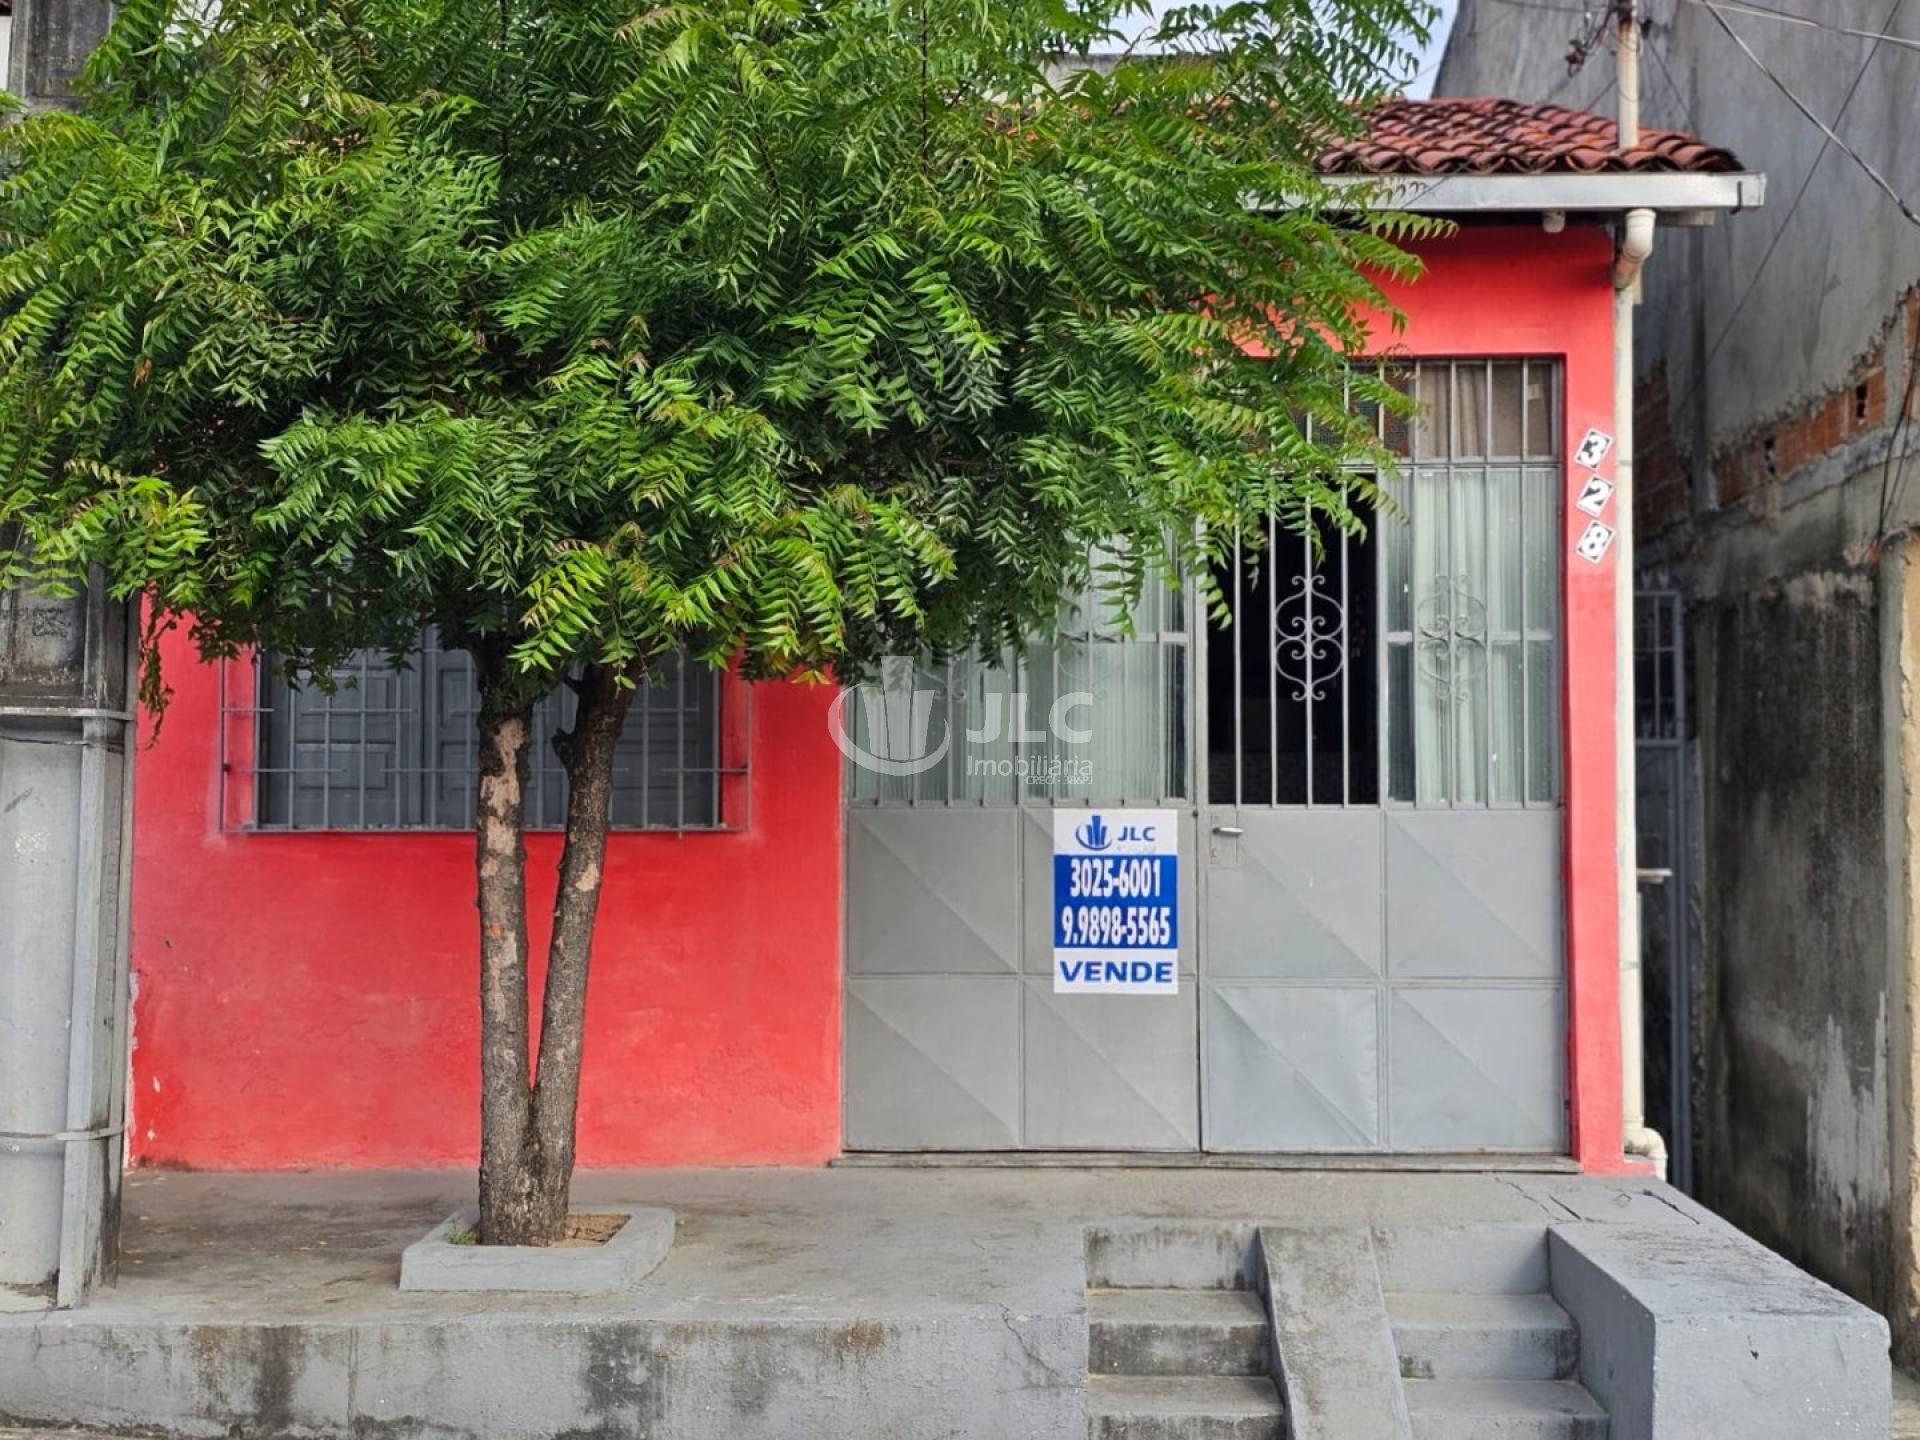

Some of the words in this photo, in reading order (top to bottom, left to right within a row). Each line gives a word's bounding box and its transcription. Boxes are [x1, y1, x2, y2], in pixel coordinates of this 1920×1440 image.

[1116, 826, 1156, 842] JLC
[1070, 858, 1161, 898] 3025-6001
[1061, 905, 1171, 946] 9.9898-5565
[1059, 961, 1173, 983] VENDE
